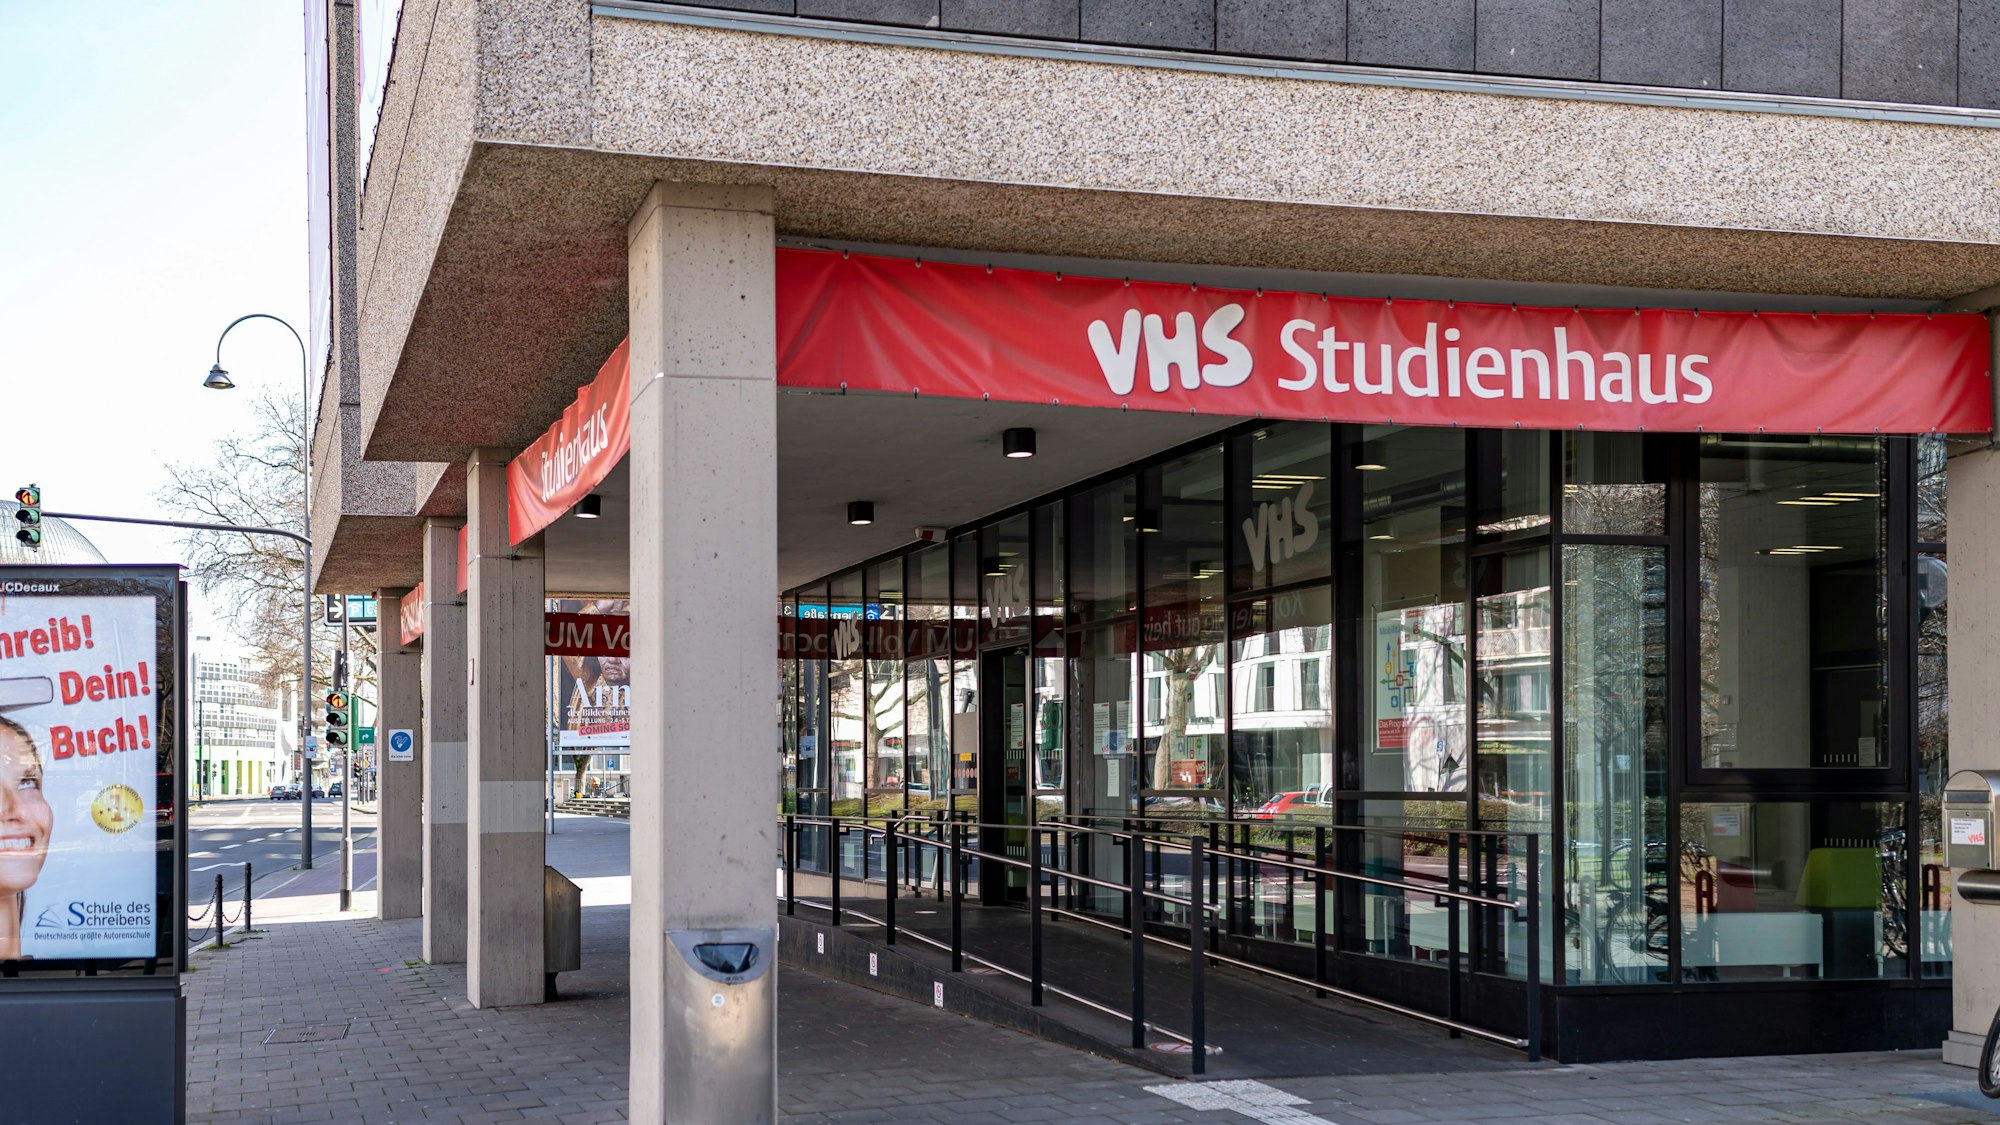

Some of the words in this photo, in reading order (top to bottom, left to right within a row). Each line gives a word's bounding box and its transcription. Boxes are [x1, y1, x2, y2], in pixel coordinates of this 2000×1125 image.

[1087, 303, 1254, 395] VHS
[1278, 319, 1714, 405] Studienhaus
[1242, 480, 1319, 573] VHS
[986, 564, 1026, 629] VHS
[834, 612, 860, 660] VHS
[59, 661, 151, 706] Dein!
[49, 714, 151, 761] Buch!
[580, 725, 616, 736] COMING
[126, 901, 151, 914] des
[34, 931, 78, 941] Deutschlands
[103, 931, 151, 940] Autorenschule
